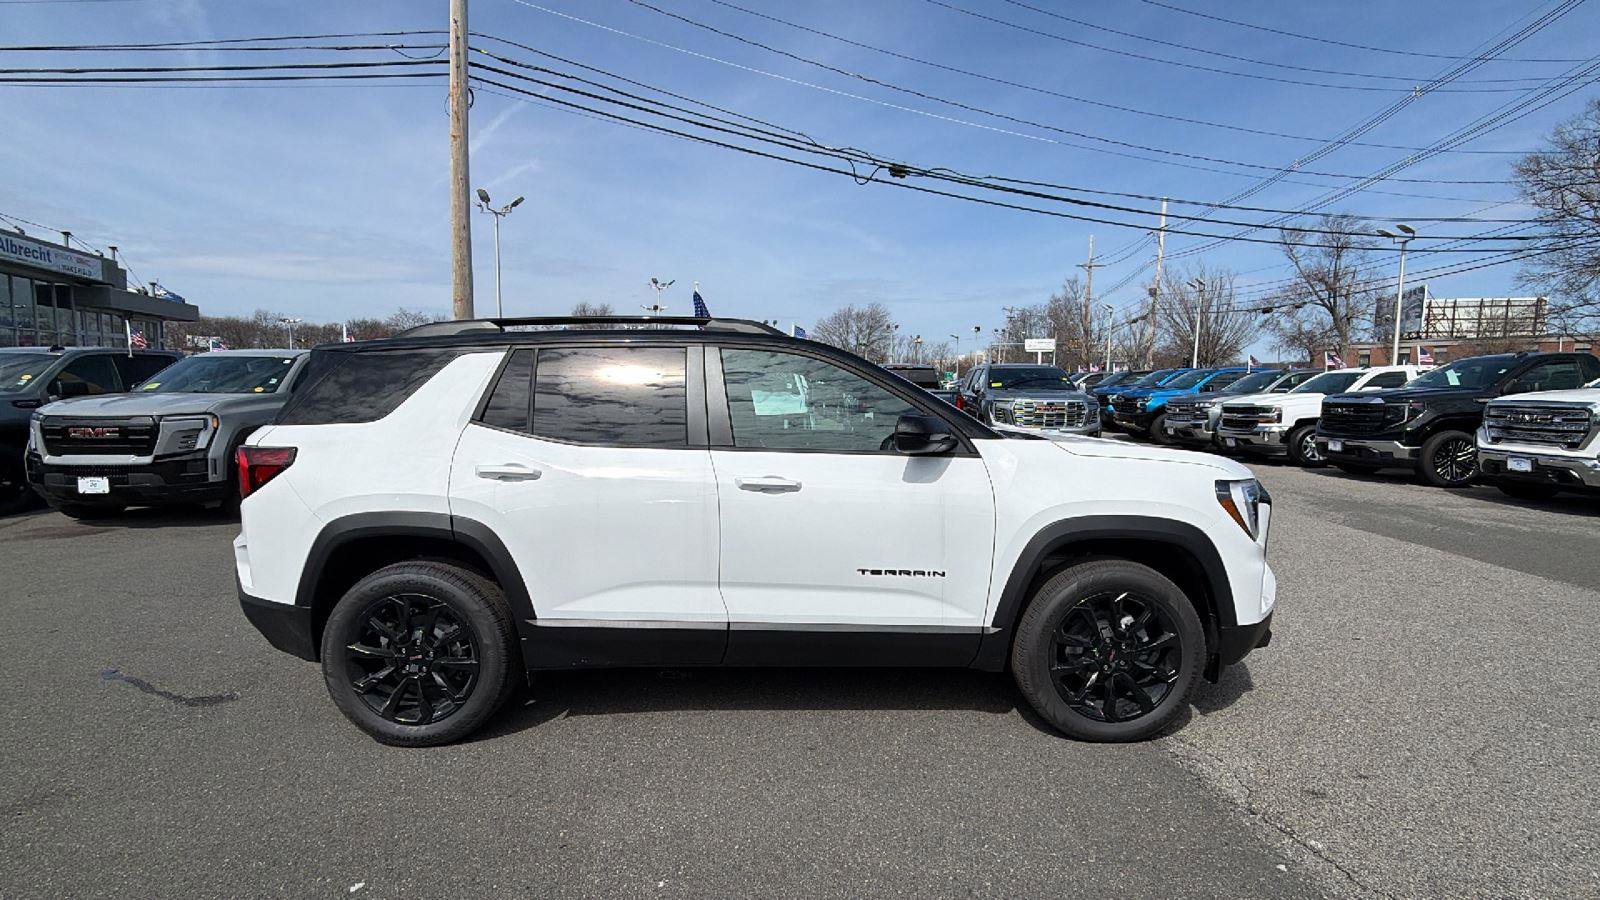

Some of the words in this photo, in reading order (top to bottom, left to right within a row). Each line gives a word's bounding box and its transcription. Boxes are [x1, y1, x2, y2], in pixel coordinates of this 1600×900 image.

[0, 236, 52, 263] Albrecht
[68, 427, 119, 438] GMC
[857, 568, 946, 577] TERRAIN
